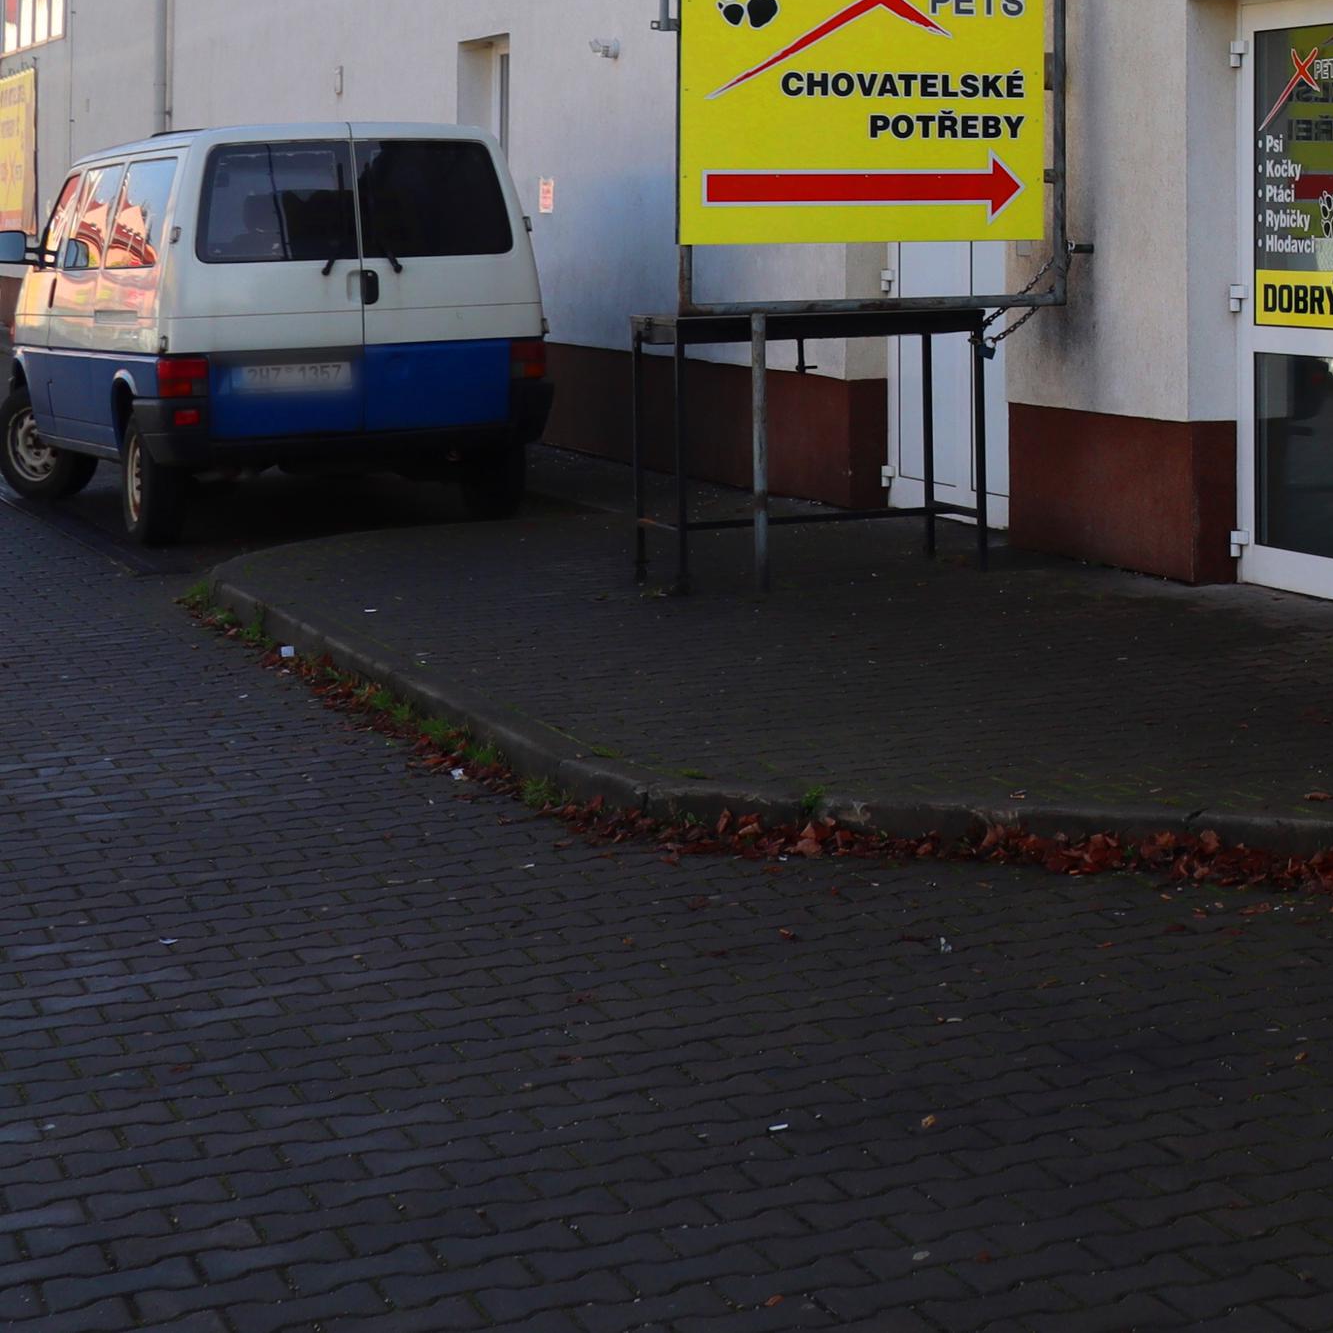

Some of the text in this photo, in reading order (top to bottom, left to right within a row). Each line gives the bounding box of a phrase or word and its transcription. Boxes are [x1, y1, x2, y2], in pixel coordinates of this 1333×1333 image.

[781, 69, 1025, 99] CHOVATELSKÉ
[868, 109, 1025, 140] POTŘEBY
[1265, 134, 1283, 153] Psi
[1265, 159, 1302, 181] Kočky
[1265, 184, 1295, 203] Ptáci
[1265, 209, 1311, 232] Rybičky
[1265, 234, 1316, 254] Hlodavci
